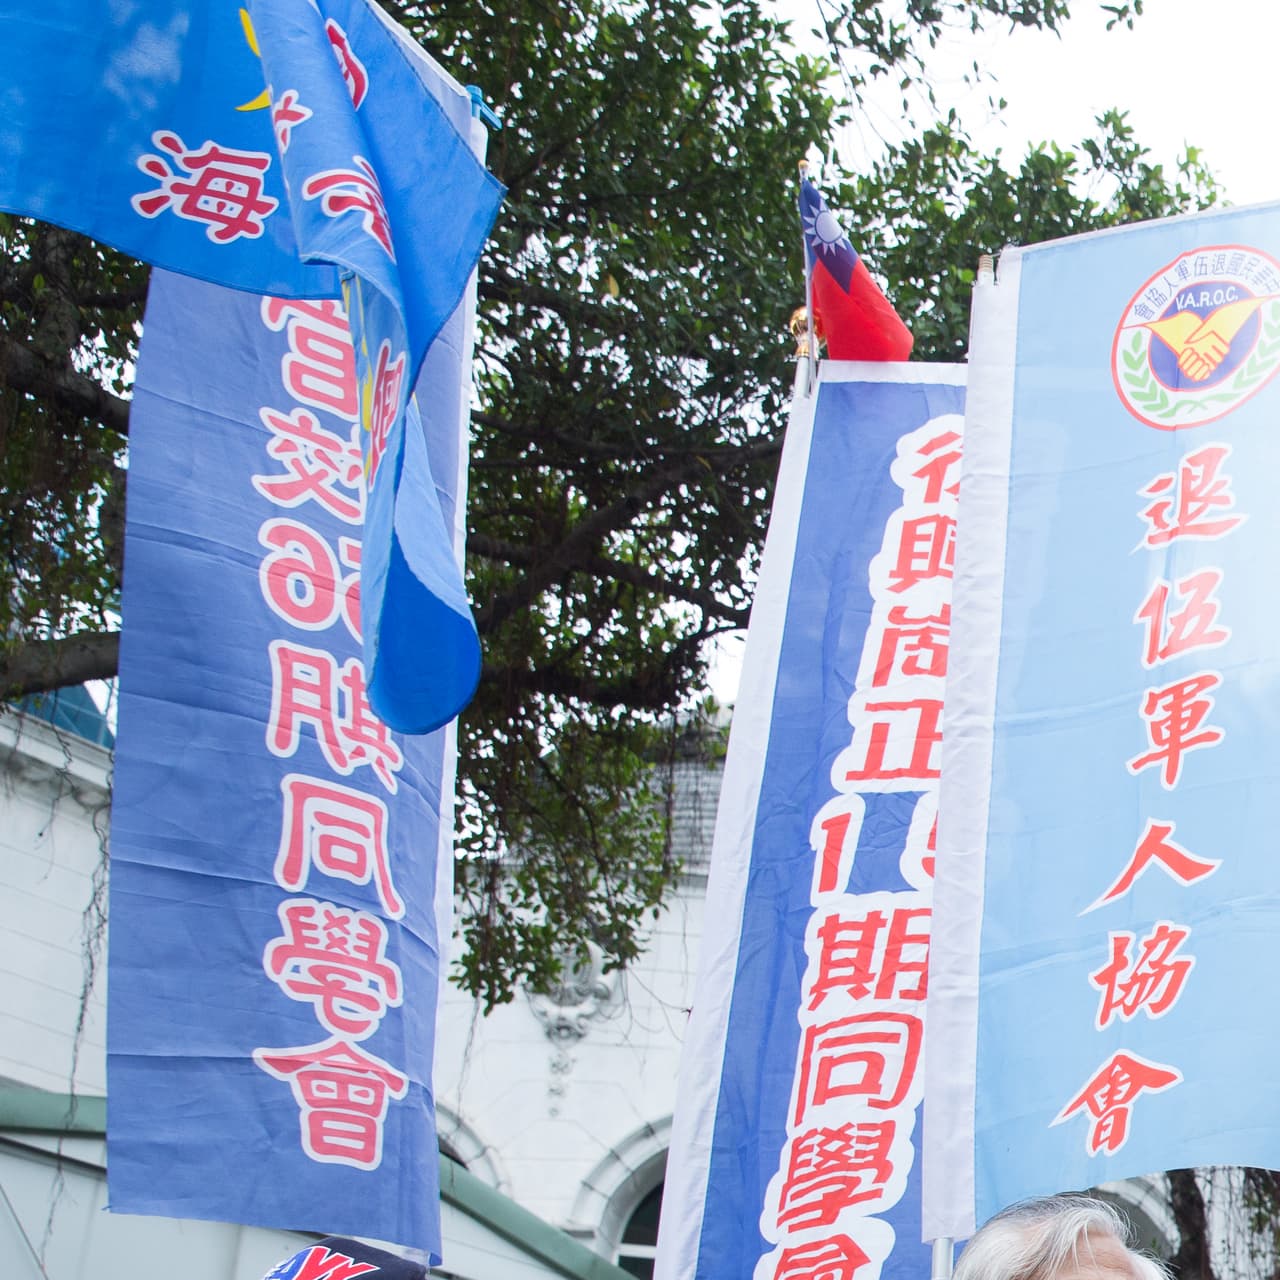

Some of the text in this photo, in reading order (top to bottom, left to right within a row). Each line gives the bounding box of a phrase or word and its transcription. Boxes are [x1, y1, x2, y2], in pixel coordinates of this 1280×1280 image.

[131, 130, 279, 244] 海
[1054, 446, 1247, 1154] 退伍軍人協會
